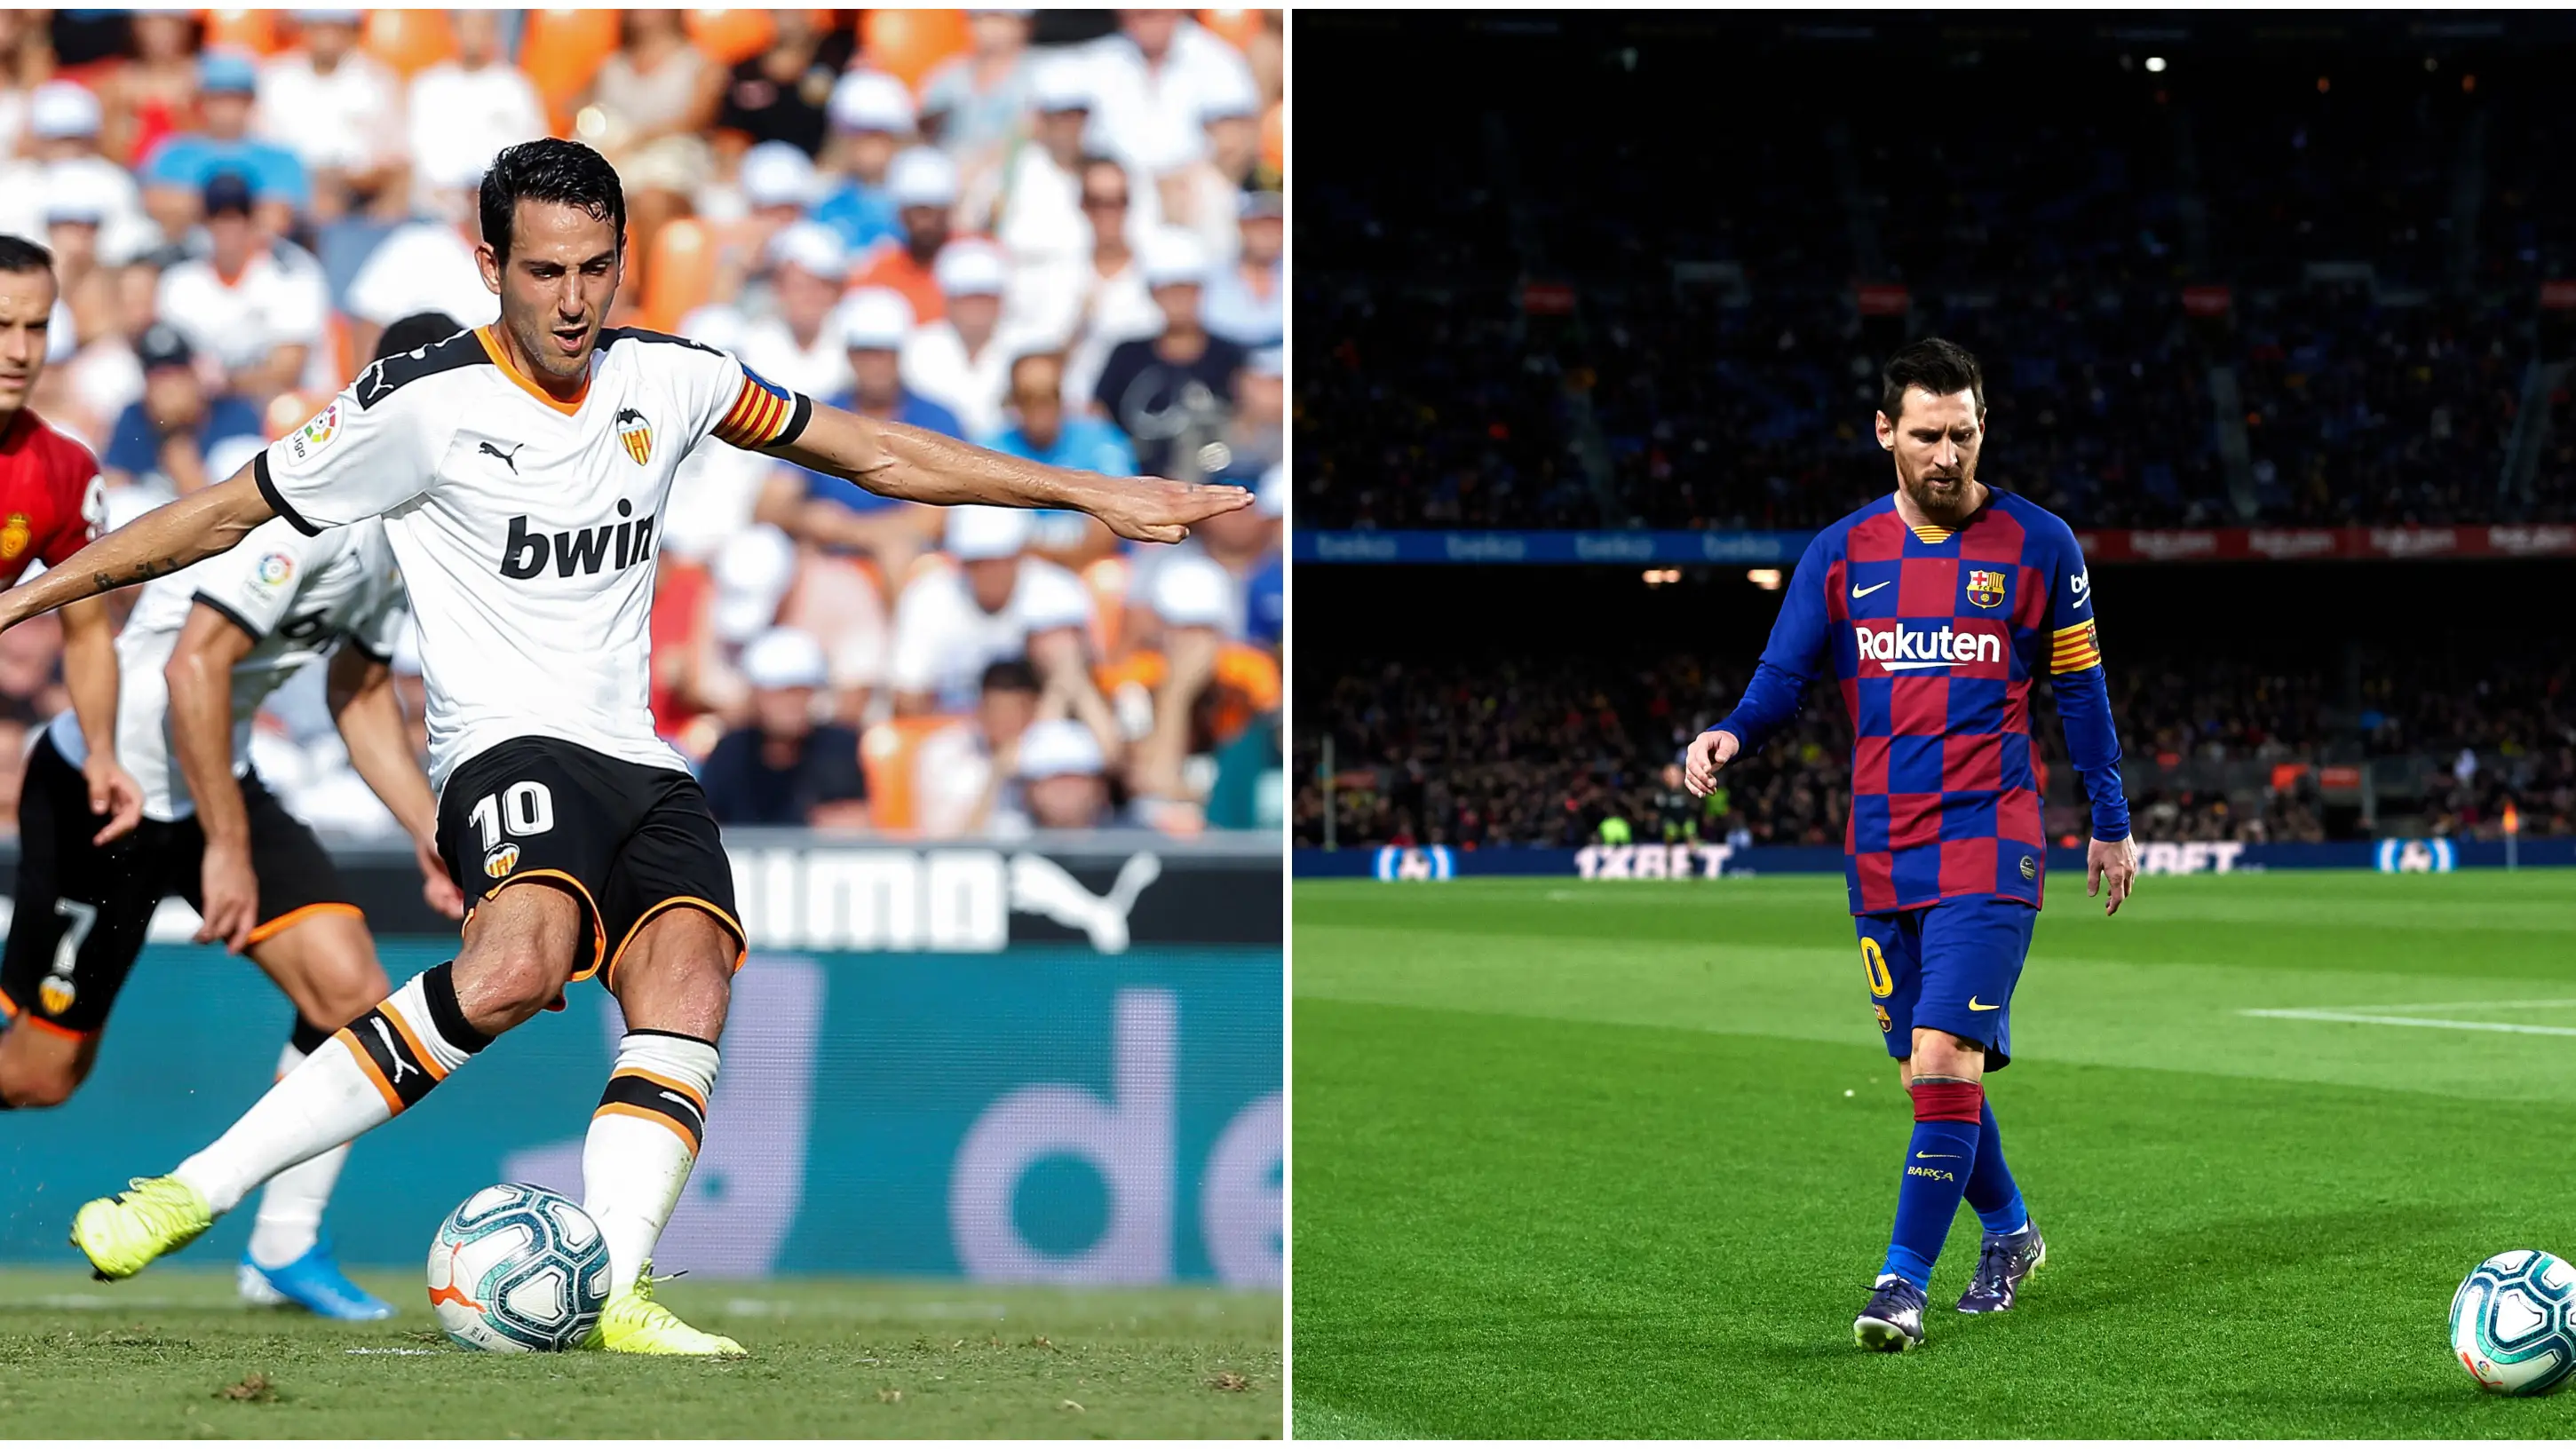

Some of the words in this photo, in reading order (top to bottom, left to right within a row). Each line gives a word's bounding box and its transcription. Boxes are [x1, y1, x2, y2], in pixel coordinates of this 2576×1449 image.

[500, 498, 654, 580] bwin
[1855, 623, 2001, 663] Rakuten
[468, 780, 554, 852] 10
[54, 896, 98, 975] 7
[1906, 1165, 1954, 1182] BARÇA
